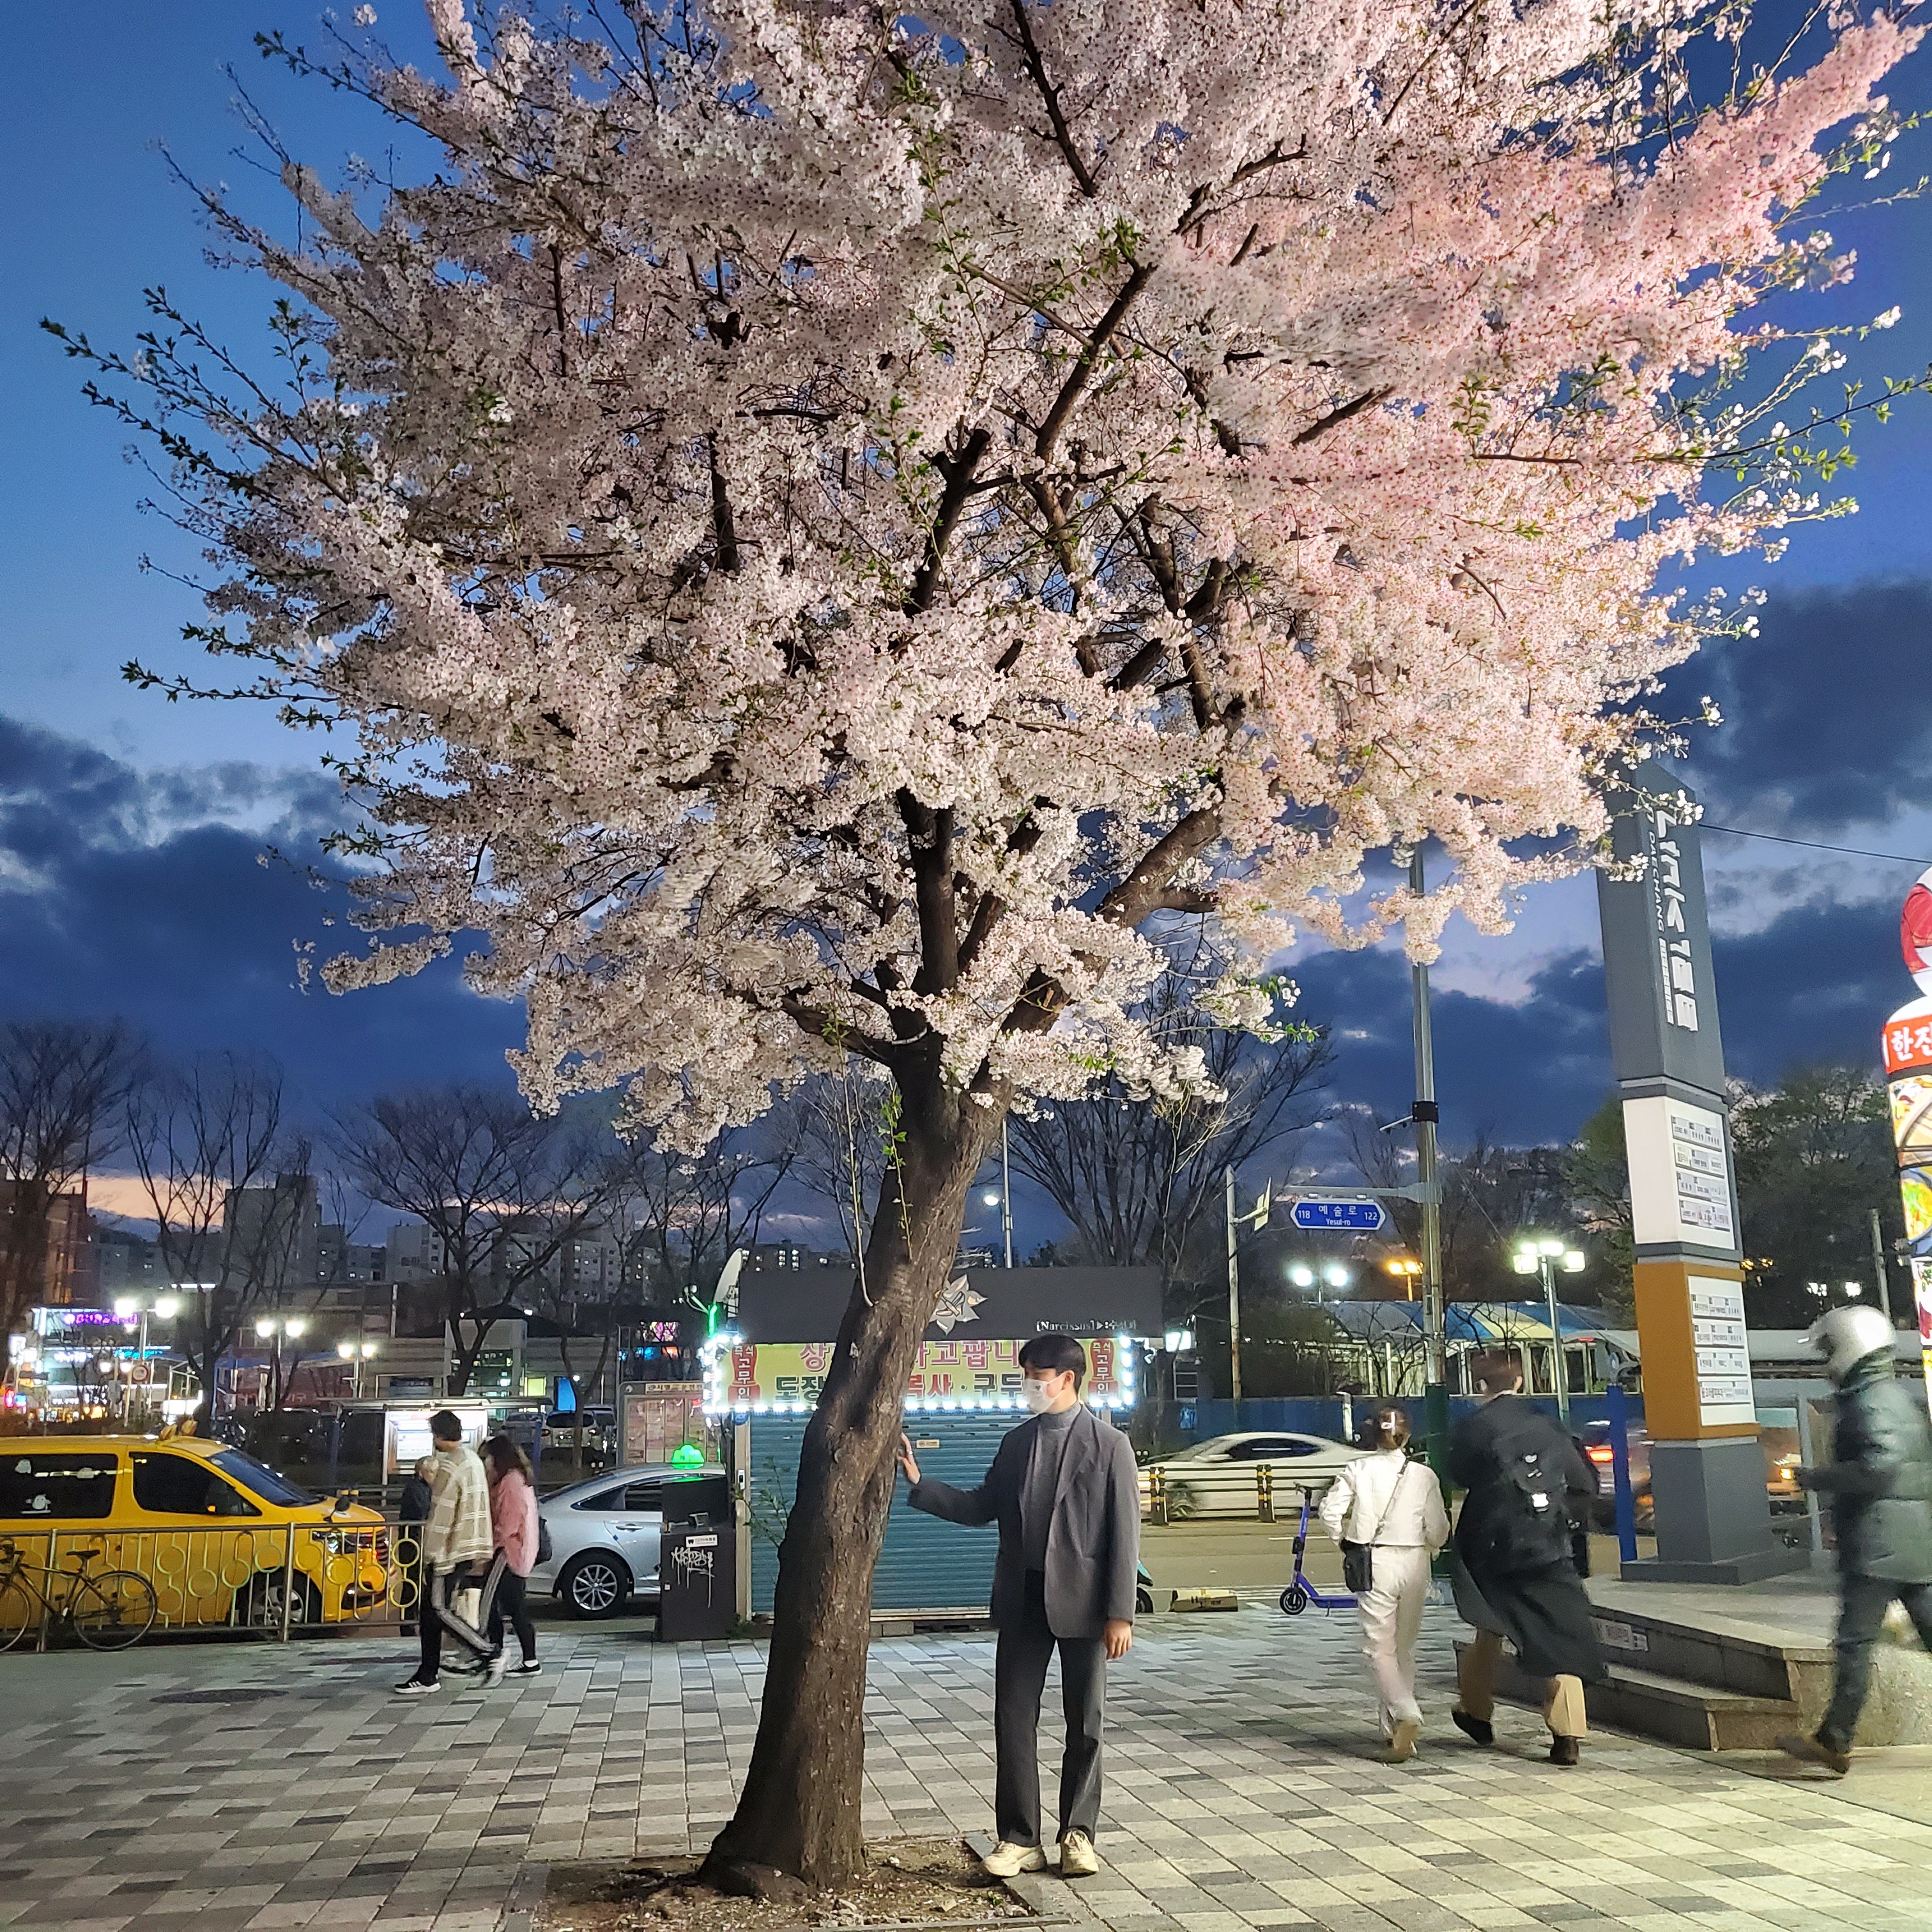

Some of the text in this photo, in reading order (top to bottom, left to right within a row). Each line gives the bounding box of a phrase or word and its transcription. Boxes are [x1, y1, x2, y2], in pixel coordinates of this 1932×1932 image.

[1649, 831, 1664, 932] DAECHANG
[1298, 1210, 1310, 1219] 118
[1364, 1212, 1378, 1220] 122
[1326, 1218, 1351, 1226] Yesul-ro
[734, 1344, 755, 1357] 즉석
[1092, 1341, 1112, 1354] 즉석
[737, 1358, 751, 1402] 고무인
[1096, 1354, 1110, 1397] 고무인
